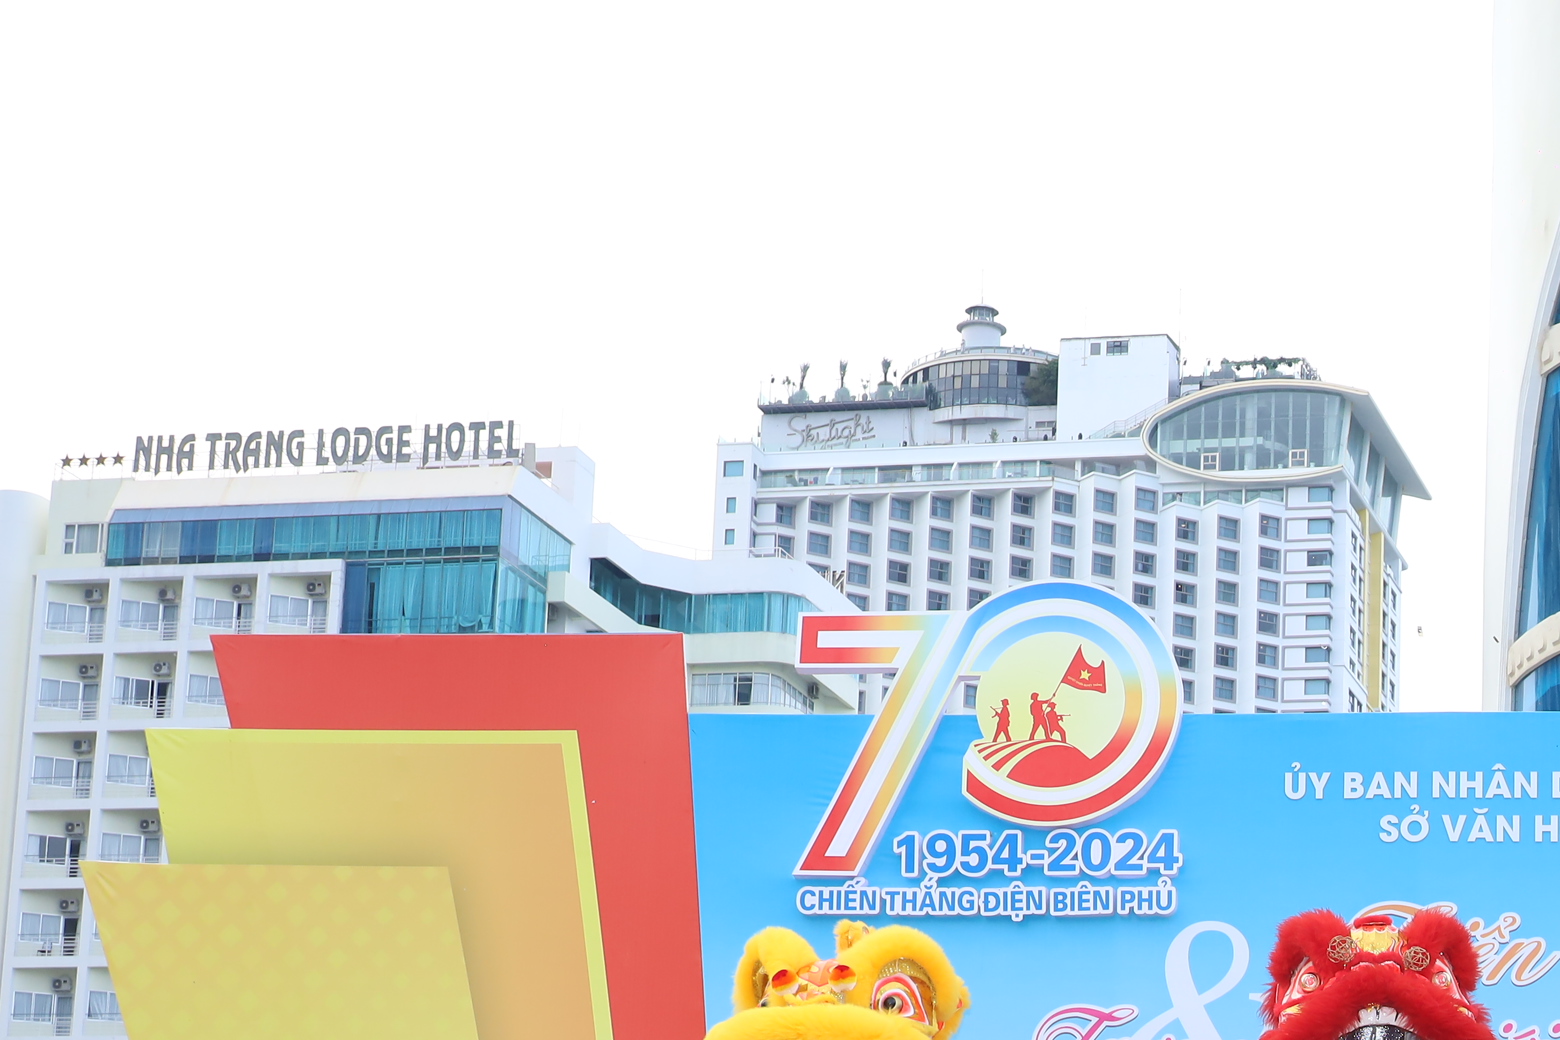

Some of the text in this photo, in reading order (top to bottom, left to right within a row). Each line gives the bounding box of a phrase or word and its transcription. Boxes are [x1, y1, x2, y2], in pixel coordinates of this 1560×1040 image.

[132, 420, 520, 475] NHA TRANG LODGE HOTEL
[1285, 762, 1331, 799] ỦY
[1343, 771, 1418, 799] BAN
[1432, 763, 1538, 799] NHÂN
[1379, 804, 1430, 843] SỞ
[1441, 807, 1520, 842] VĂN
[894, 830, 1183, 877] 1954-2024
[800, 876, 1175, 919] CHIẾN THẮNG ĐIỆN BIÊN PHỦ
